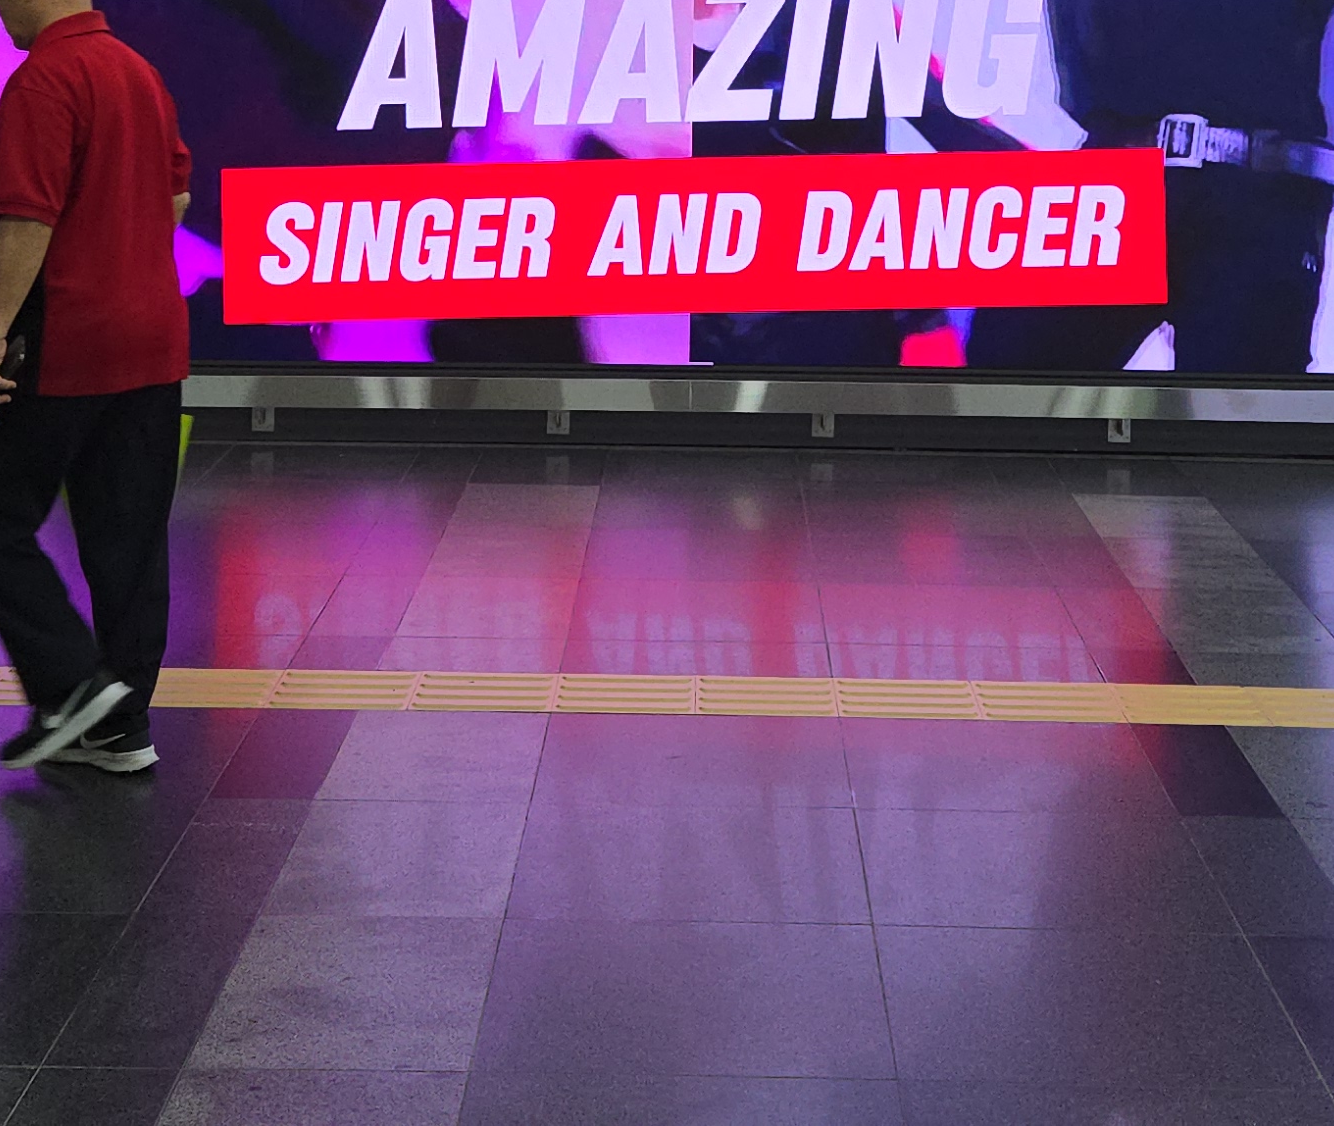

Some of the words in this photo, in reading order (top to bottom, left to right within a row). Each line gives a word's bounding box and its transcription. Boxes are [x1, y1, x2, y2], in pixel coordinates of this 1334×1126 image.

[258, 196, 556, 285] SINGER
[586, 190, 762, 277] AND
[796, 184, 1127, 274] DANCER
